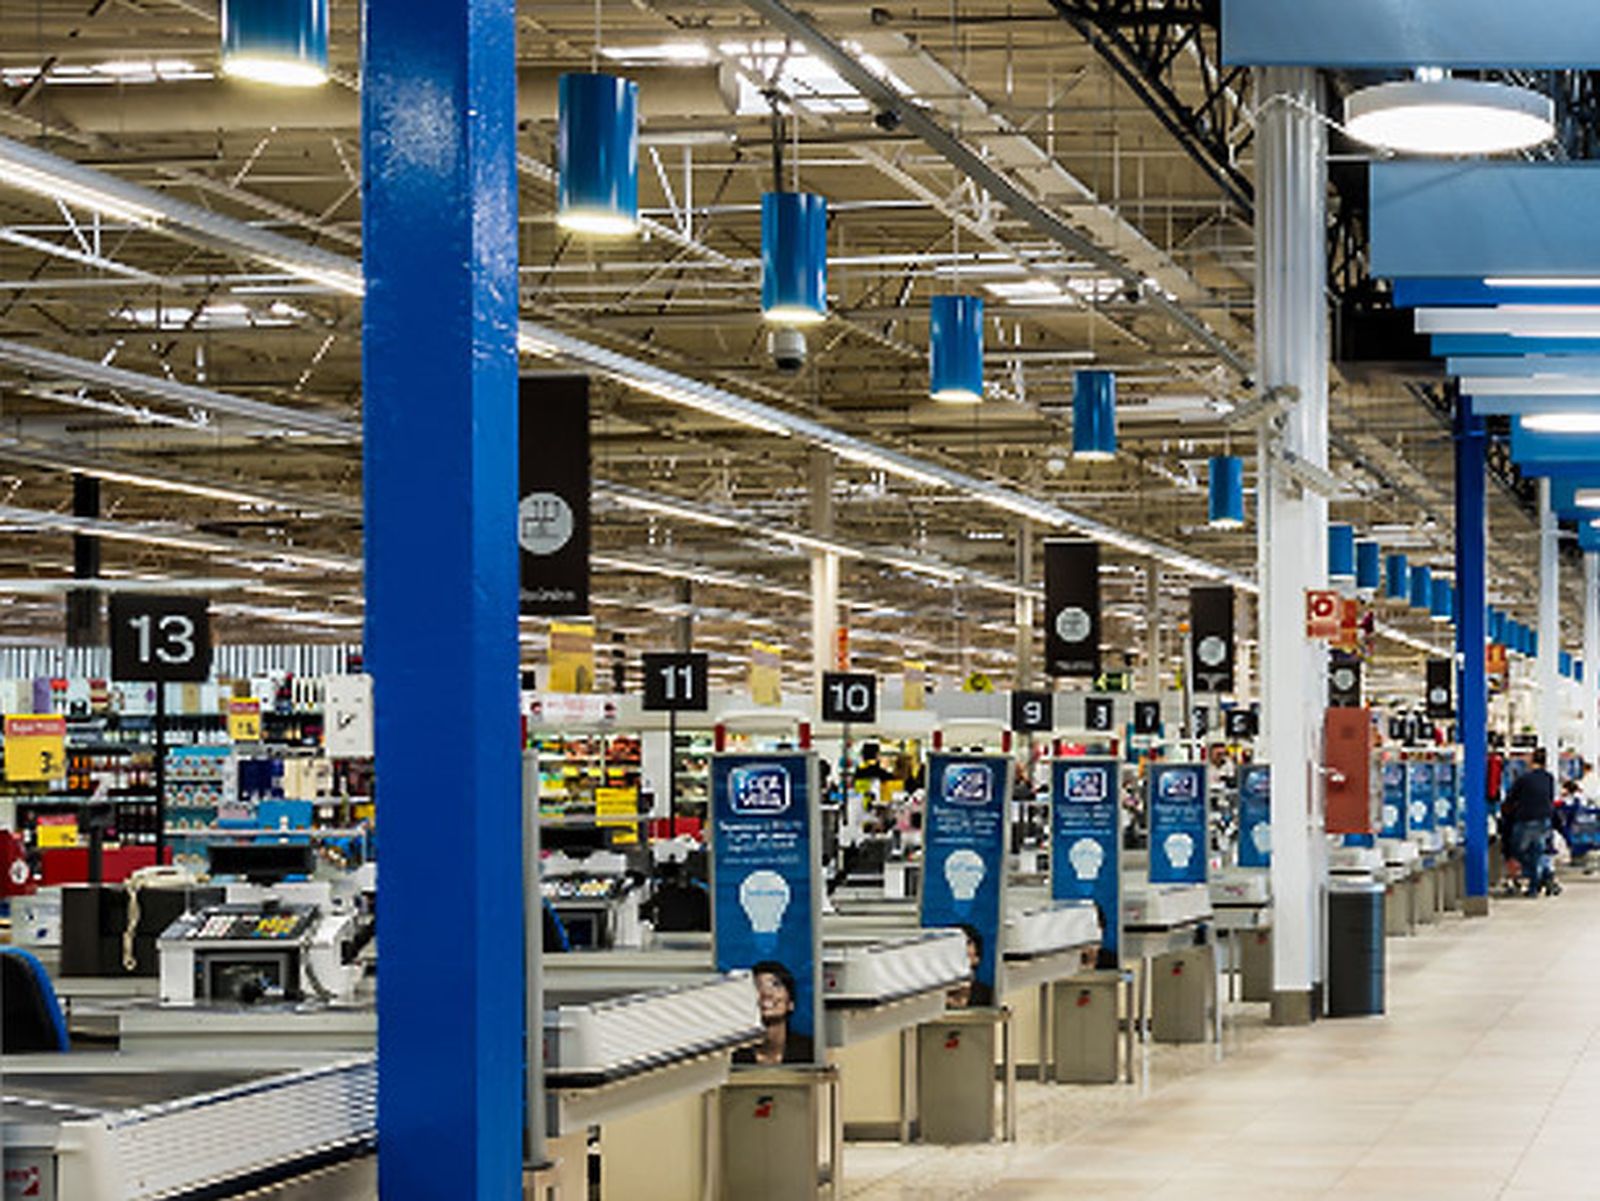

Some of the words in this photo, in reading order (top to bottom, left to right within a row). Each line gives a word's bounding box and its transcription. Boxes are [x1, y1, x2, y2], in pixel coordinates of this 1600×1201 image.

[129, 614, 195, 663] 13
[660, 665, 693, 700] 11
[830, 683, 870, 713] 10
[1023, 701, 1042, 725] 9
